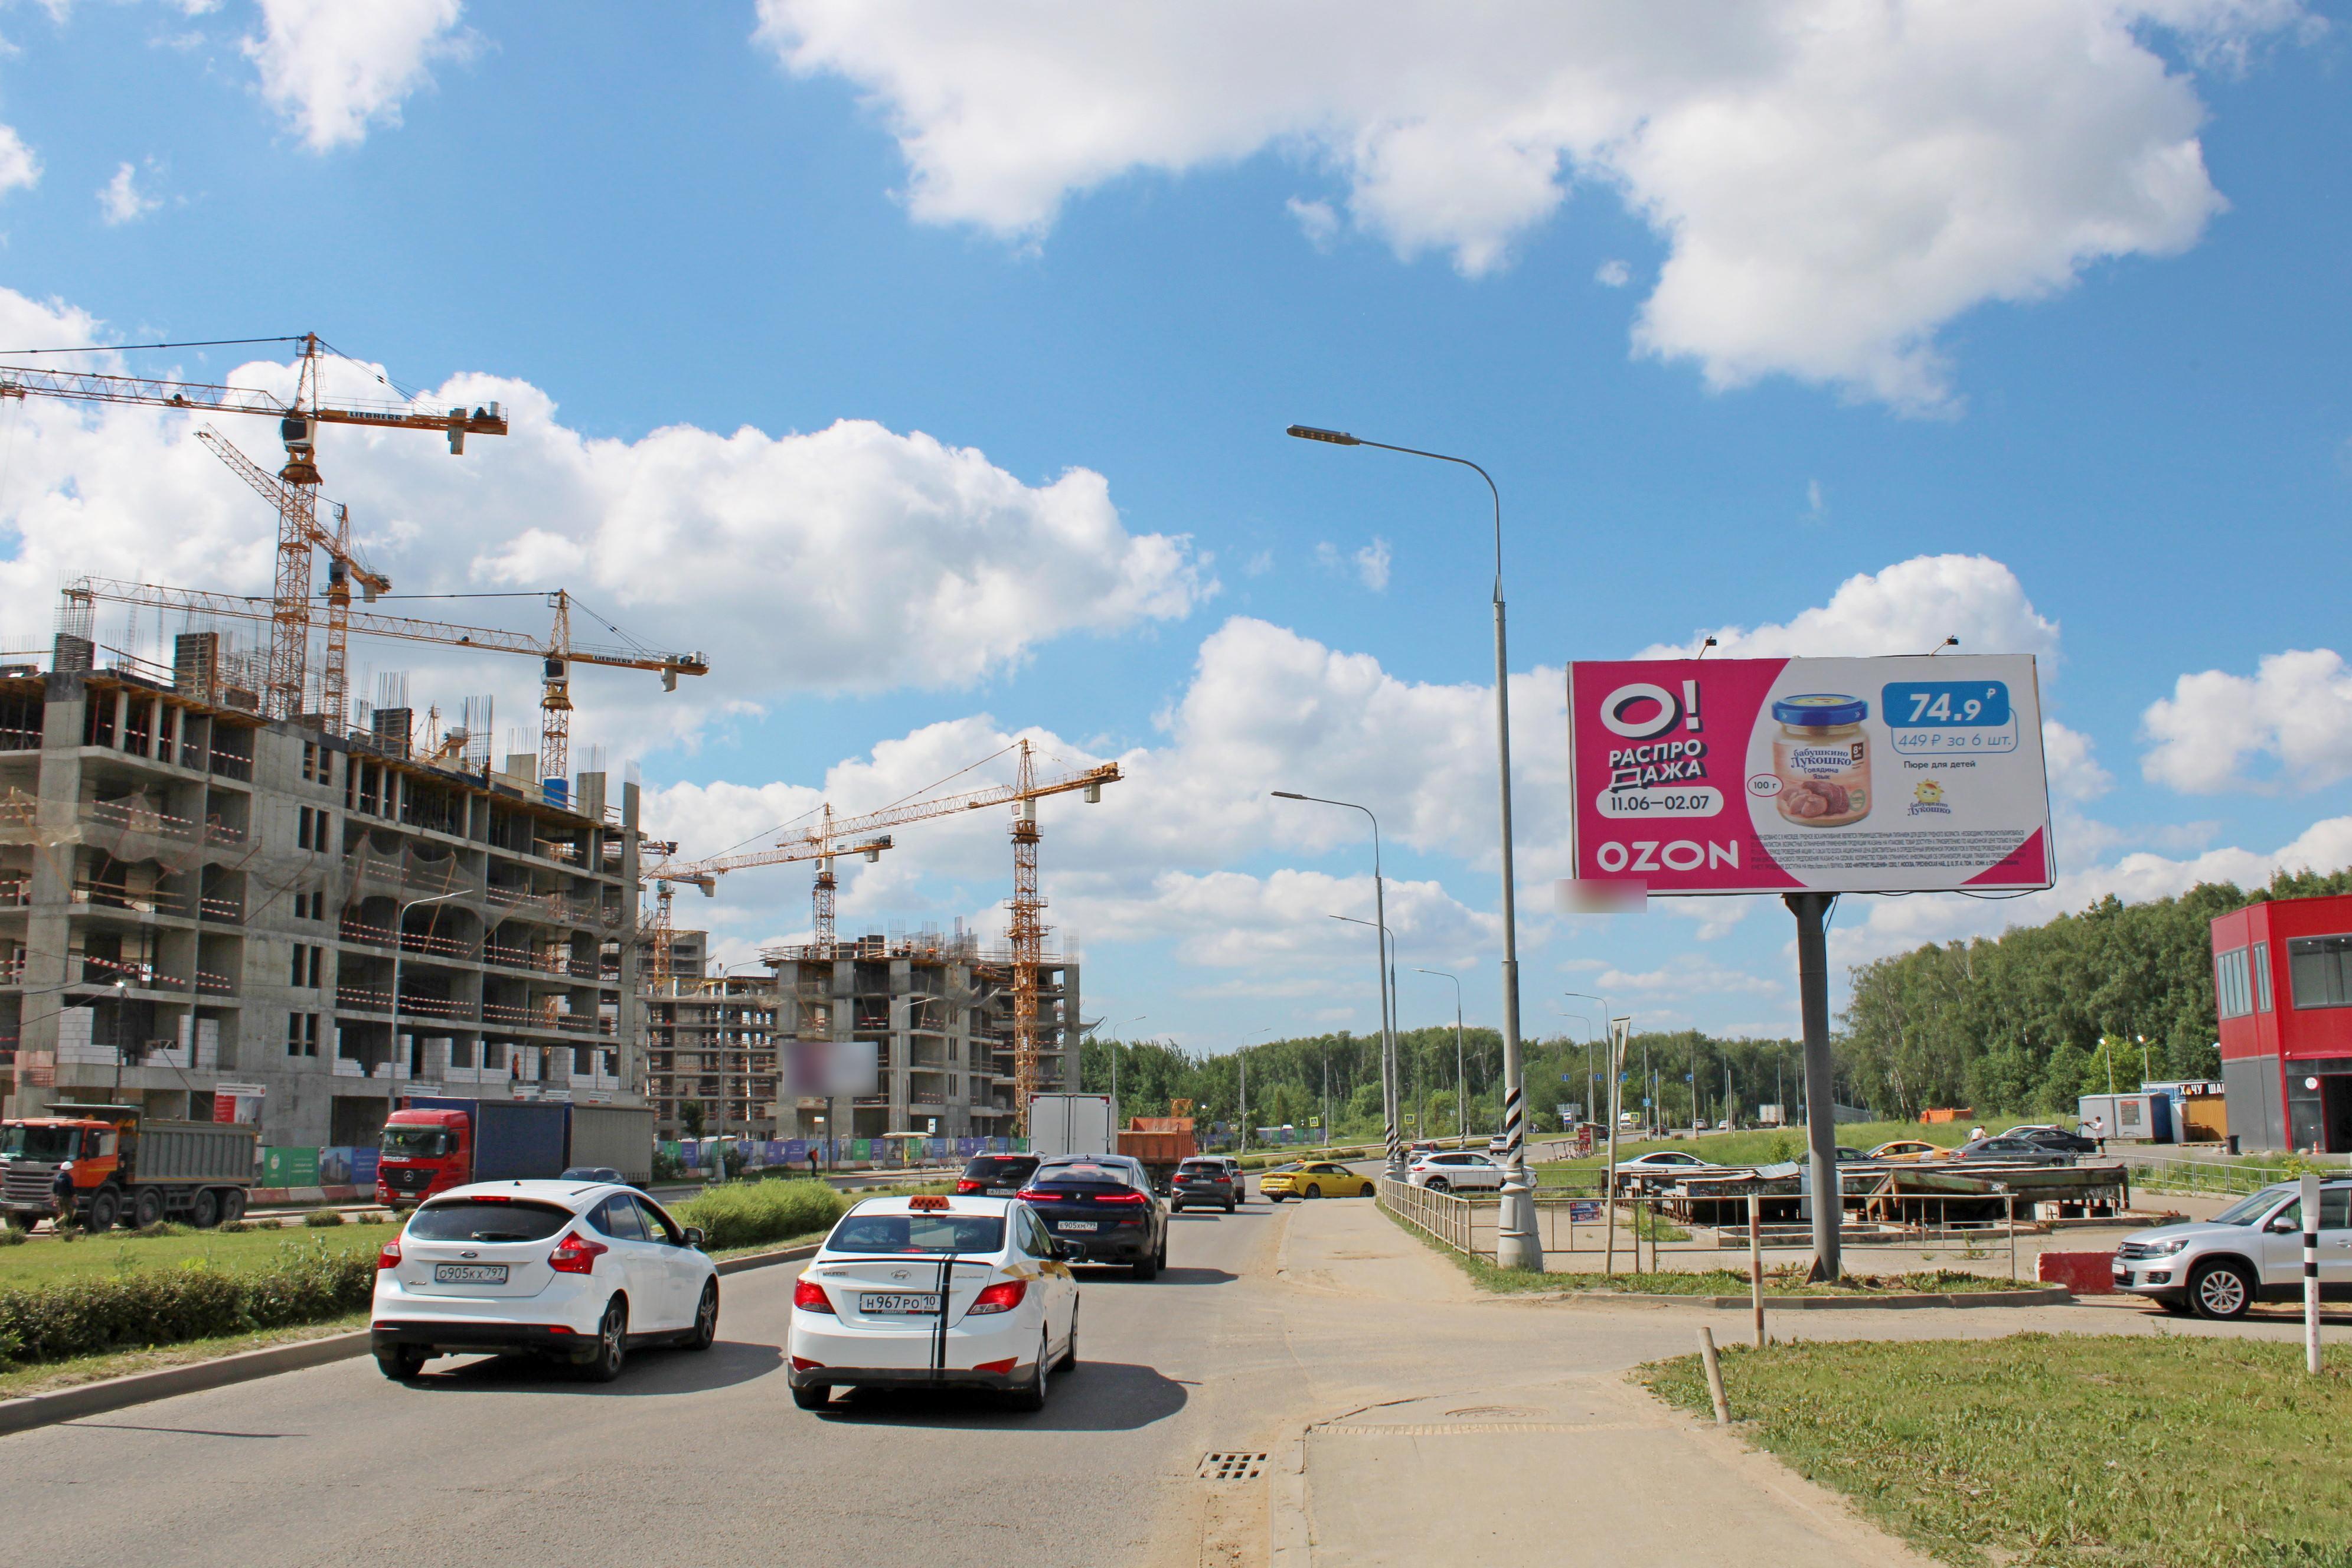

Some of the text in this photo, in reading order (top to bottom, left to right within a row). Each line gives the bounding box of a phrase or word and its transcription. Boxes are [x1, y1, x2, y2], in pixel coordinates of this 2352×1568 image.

[349, 411, 403, 421] LIEBHERR
[594, 655, 633, 665] LIEBHERR
[1600, 680, 1701, 739] О!
[1908, 693, 1981, 722] 74.9
[1899, 734, 1927, 747] 449
[1947, 737, 1965, 746] за
[1972, 733, 1981, 746] 6
[1988, 736, 2011, 746] шт.
[1609, 739, 1701, 767] РАСПРО
[1794, 748, 1848, 757] бабушкино
[1791, 756, 1851, 768] Лукошко
[1904, 761, 1929, 769] Пюре
[1950, 760, 1975, 769] детей
[1609, 760, 1701, 790] ДАЖА
[1907, 806, 1951, 816] Лукошко
[1597, 839, 1739, 873] OZON
[439, 1267, 504, 1279] О905КХ 797
[867, 1296, 936, 1309] Н967РО 10
